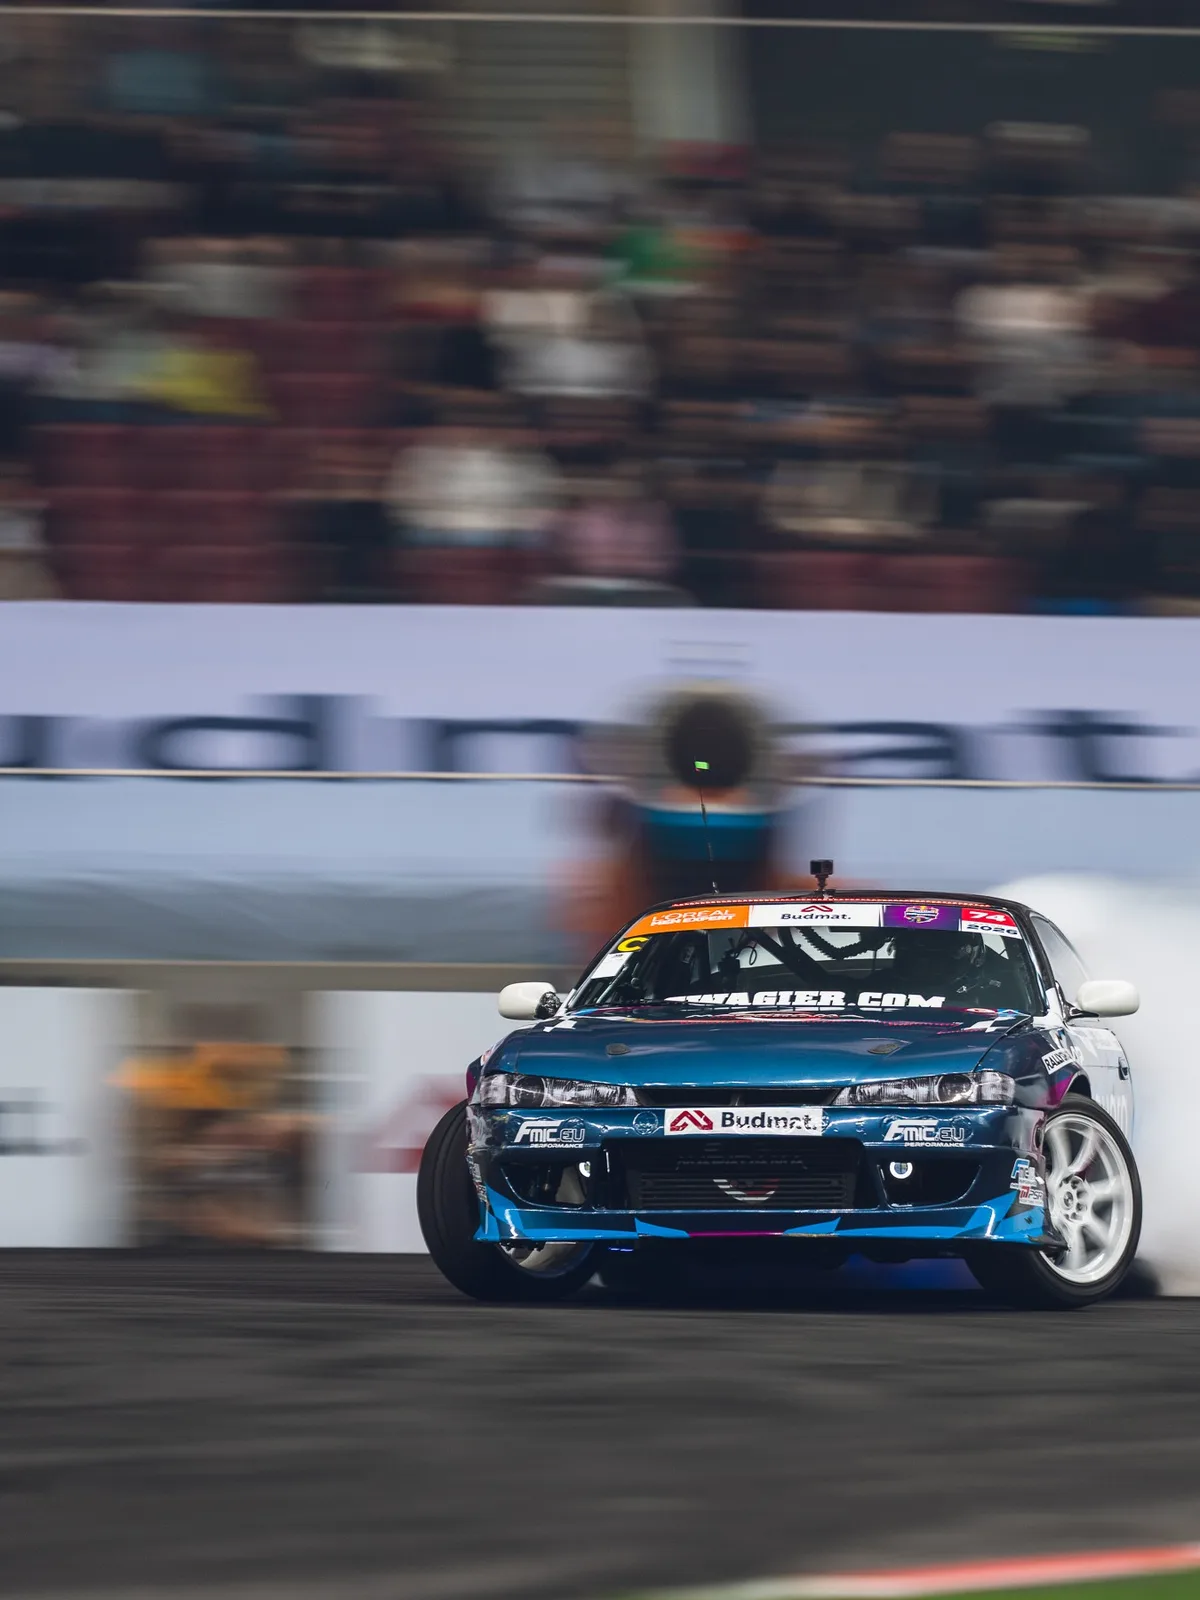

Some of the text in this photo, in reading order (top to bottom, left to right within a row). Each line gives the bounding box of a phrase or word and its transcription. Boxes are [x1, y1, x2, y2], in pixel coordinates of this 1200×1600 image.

[780, 912, 851, 920] Budmat.
[969, 911, 1006, 922] 74
[966, 924, 1018, 935] 2026
[617, 937, 649, 952] C
